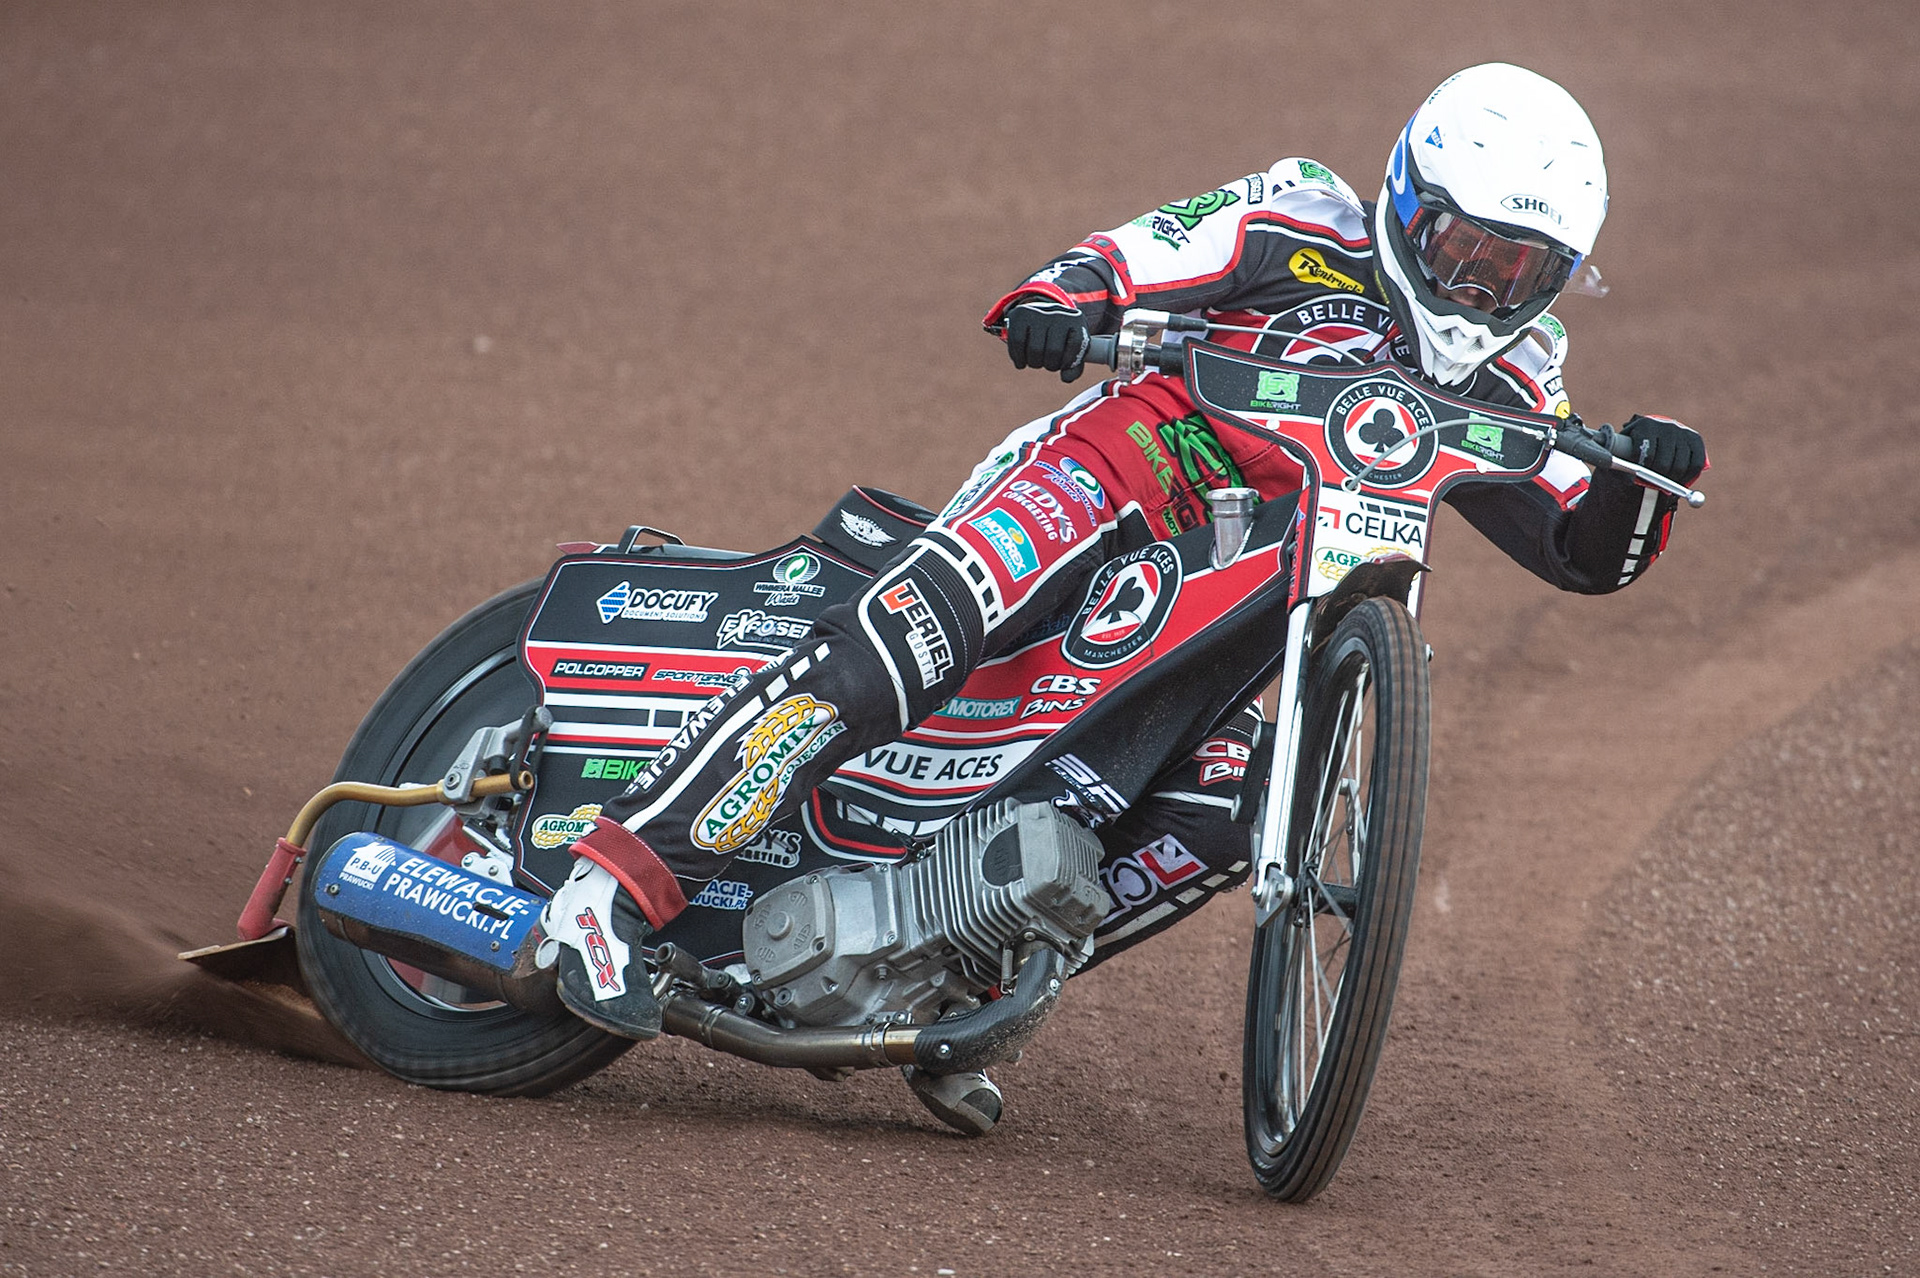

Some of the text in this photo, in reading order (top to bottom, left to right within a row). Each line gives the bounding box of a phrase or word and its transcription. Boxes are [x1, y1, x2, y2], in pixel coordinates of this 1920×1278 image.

[1512, 197, 1562, 225] SHOEI
[1298, 252, 1362, 293] Rentruck
[1296, 303, 1366, 325] BELLE
[1250, 400, 1301, 410] BIKERIGHT
[1336, 386, 1372, 416] BELLE
[1378, 385, 1405, 402] VUE
[1002, 490, 1058, 541] CONCRETING
[1008, 480, 1077, 544] OLDY'S
[1345, 512, 1423, 548] CELKA
[980, 517, 1026, 572] MOTOREX
[755, 583, 823, 595] WIMMERA MALLEE
[1081, 547, 1174, 615] BELLE VUE ACES
[623, 609, 663, 617] DOCUMENT
[628, 591, 715, 611] DOCUFY
[891, 582, 951, 681] TERIEL
[908, 632, 937, 686] GOSTYN
[1083, 634, 1143, 658] MANCHESTER
[554, 661, 645, 678] POLCOPPER
[1030, 674, 1101, 696] CBS
[947, 699, 1016, 718] MOTOREX
[1020, 697, 1085, 720] BINS
[864, 749, 1003, 780] VUE ACES
[1195, 740, 1251, 762] CB
[705, 715, 820, 839] AGROMIX
[540, 820, 589, 833] AGROM
[744, 849, 790, 866] RETING
[339, 872, 375, 891] PRAWUCKI
[397, 857, 530, 916] ELEWACJE-
[382, 873, 515, 940] PRAWUCKI.PL
[576, 906, 621, 991] TCX
